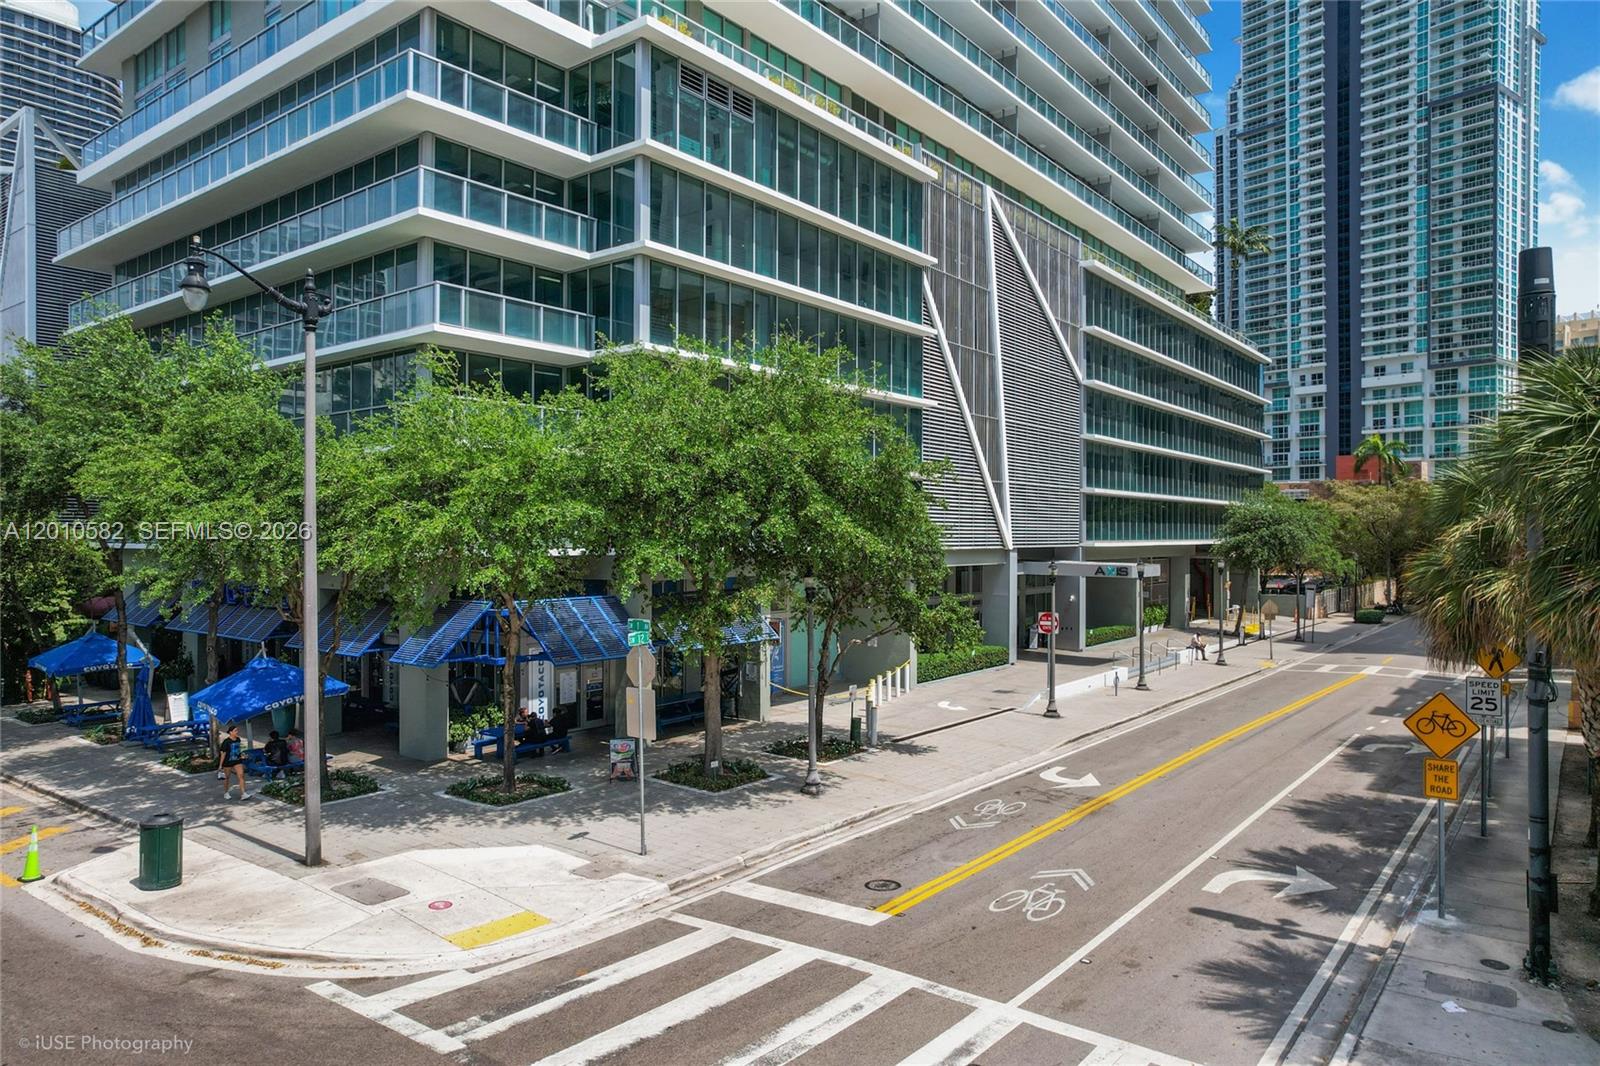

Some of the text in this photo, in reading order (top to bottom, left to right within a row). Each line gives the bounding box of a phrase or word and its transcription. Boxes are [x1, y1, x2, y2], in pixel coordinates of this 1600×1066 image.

[1468, 681, 1499, 689] SPEED
[1470, 696, 1498, 712] 25
[1427, 762, 1455, 774] SHARE
[1434, 774, 1449, 784] THE
[1430, 785, 1453, 795] ROAD
